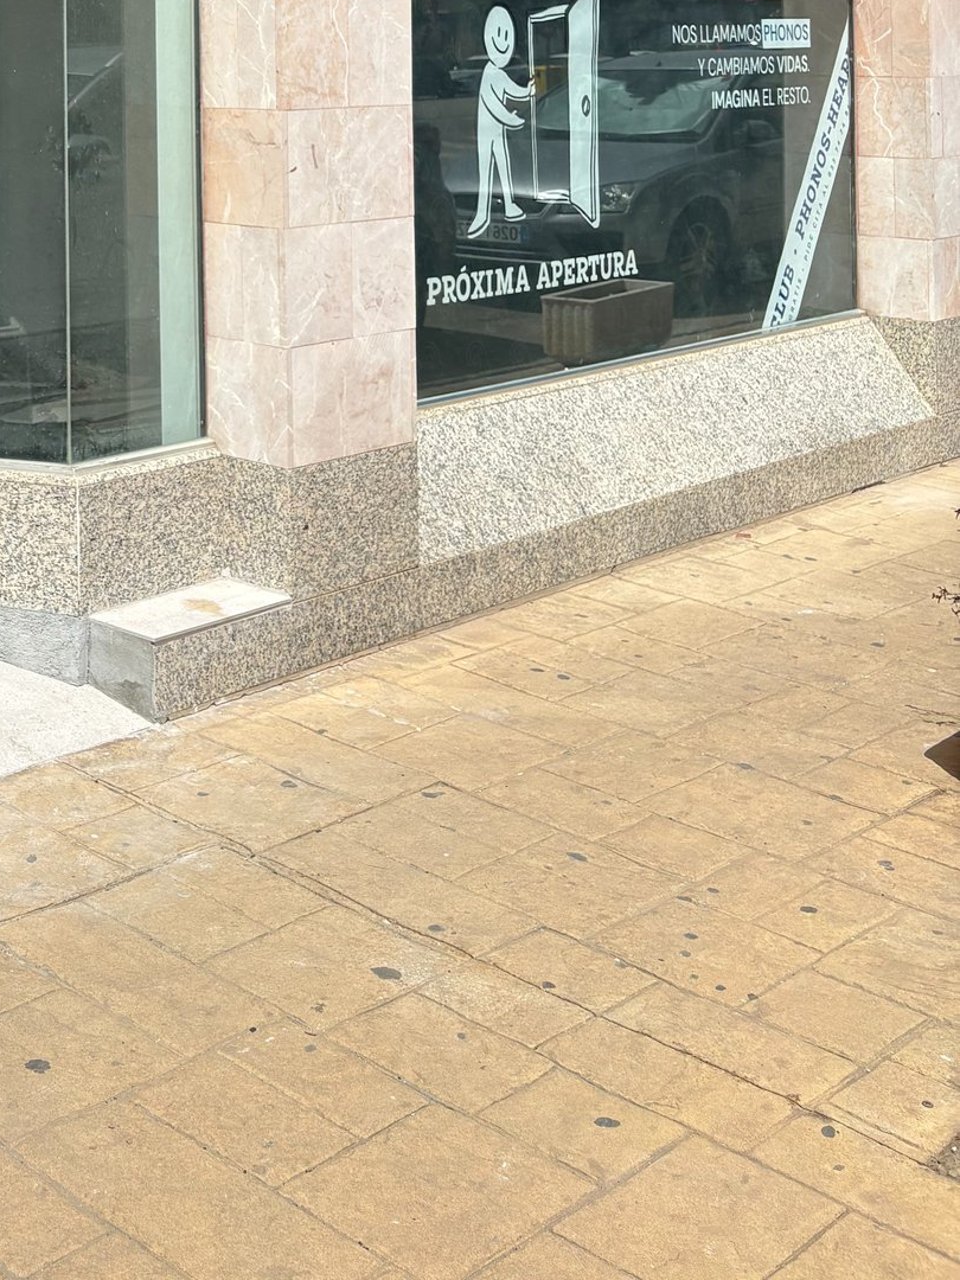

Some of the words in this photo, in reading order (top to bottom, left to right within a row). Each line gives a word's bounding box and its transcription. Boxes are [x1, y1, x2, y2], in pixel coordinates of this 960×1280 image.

[672, 24, 698, 44] NOS
[699, 23, 762, 44] LLAMAMOS
[763, 23, 809, 42] PHONOS
[697, 57, 706, 77] Y
[707, 56, 775, 77] CAMBIAMOS
[711, 89, 761, 110] IMAGINA
[762, 88, 775, 107] EL
[426, 265, 531, 306] PRÓXIMA
[536, 249, 639, 291] APERTURA
